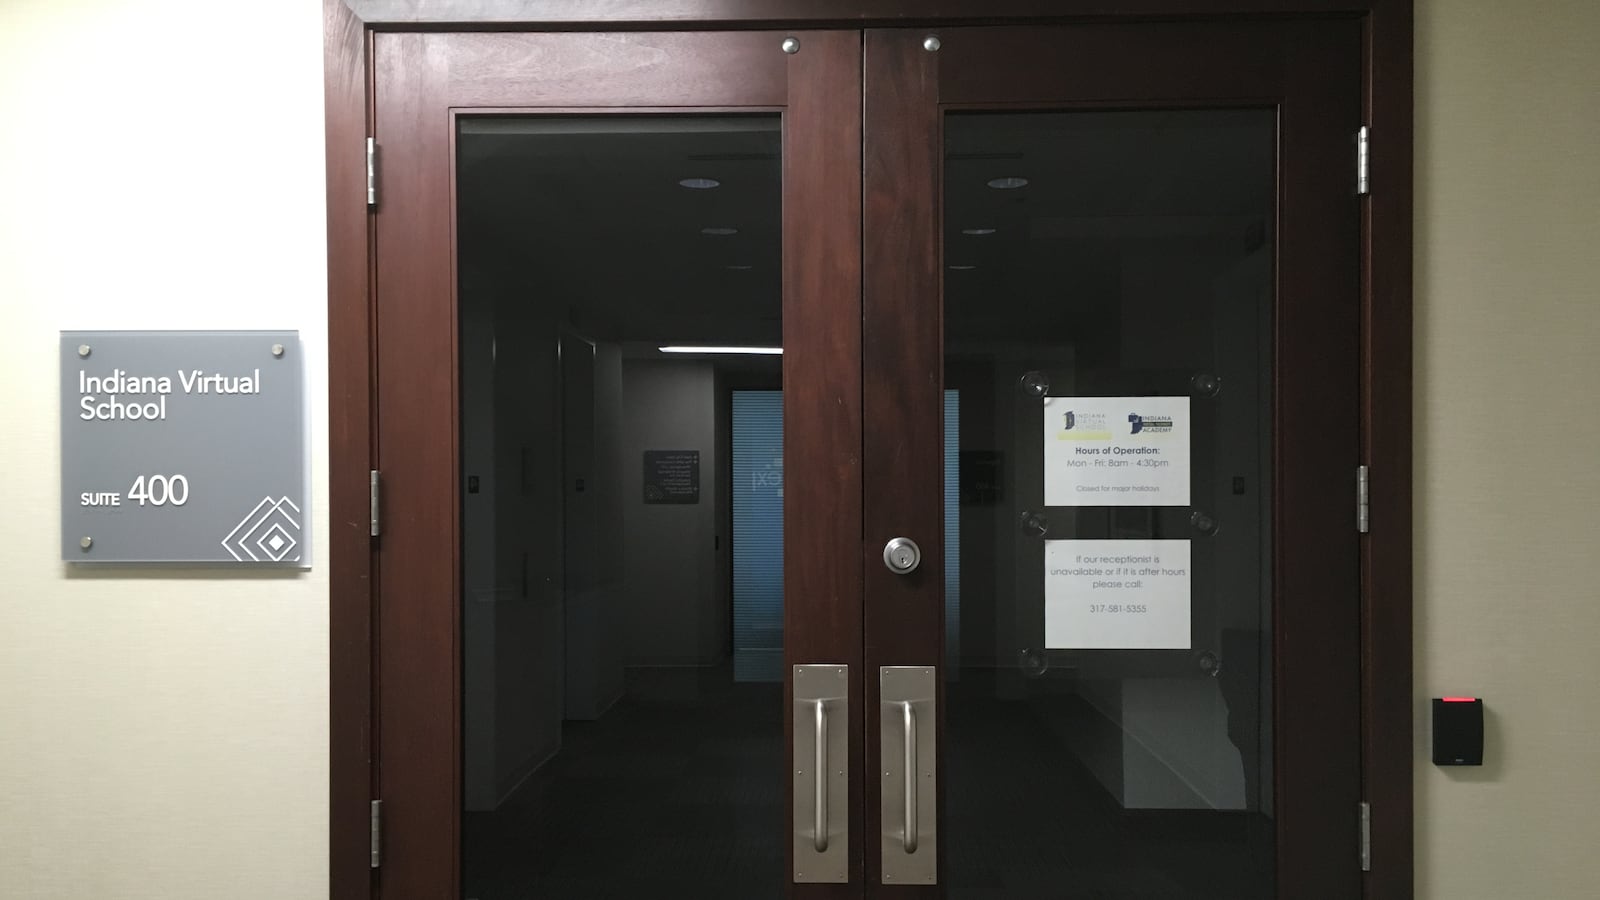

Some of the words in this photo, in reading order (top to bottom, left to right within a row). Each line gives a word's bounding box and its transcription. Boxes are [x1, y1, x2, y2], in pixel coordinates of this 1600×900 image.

[79, 369, 172, 394] Indiana
[178, 368, 260, 394] Virtual
[79, 395, 166, 420] School
[1075, 447, 1100, 455] Hours
[1102, 446, 1111, 455] of
[1113, 446, 1161, 457] Operation:
[1066, 459, 1087, 468] Mon
[1094, 459, 1106, 468] Fri:
[1108, 459, 1129, 468] 8am
[1136, 459, 1169, 469] 4:30pm
[80, 493, 121, 506] SUITE
[127, 474, 189, 506] 400
[1076, 485, 1099, 493] Closed
[1100, 485, 1110, 493] for
[1111, 485, 1131, 494] major
[1132, 485, 1160, 494] holidays
[1076, 555, 1082, 564] If
[1083, 556, 1098, 564] our
[1099, 555, 1152, 565] receptionist
[1153, 555, 1160, 564] is
[1050, 567, 1103, 576] unavailable
[1105, 568, 1114, 576] or
[1115, 567, 1121, 576] if
[1123, 567, 1129, 576] it
[1130, 567, 1137, 576] is
[1138, 567, 1160, 576] after
[1161, 567, 1186, 576] hours
[1092, 580, 1122, 590] please
[1124, 579, 1143, 589] call:
[1089, 604, 1147, 614] 317-581-5355
